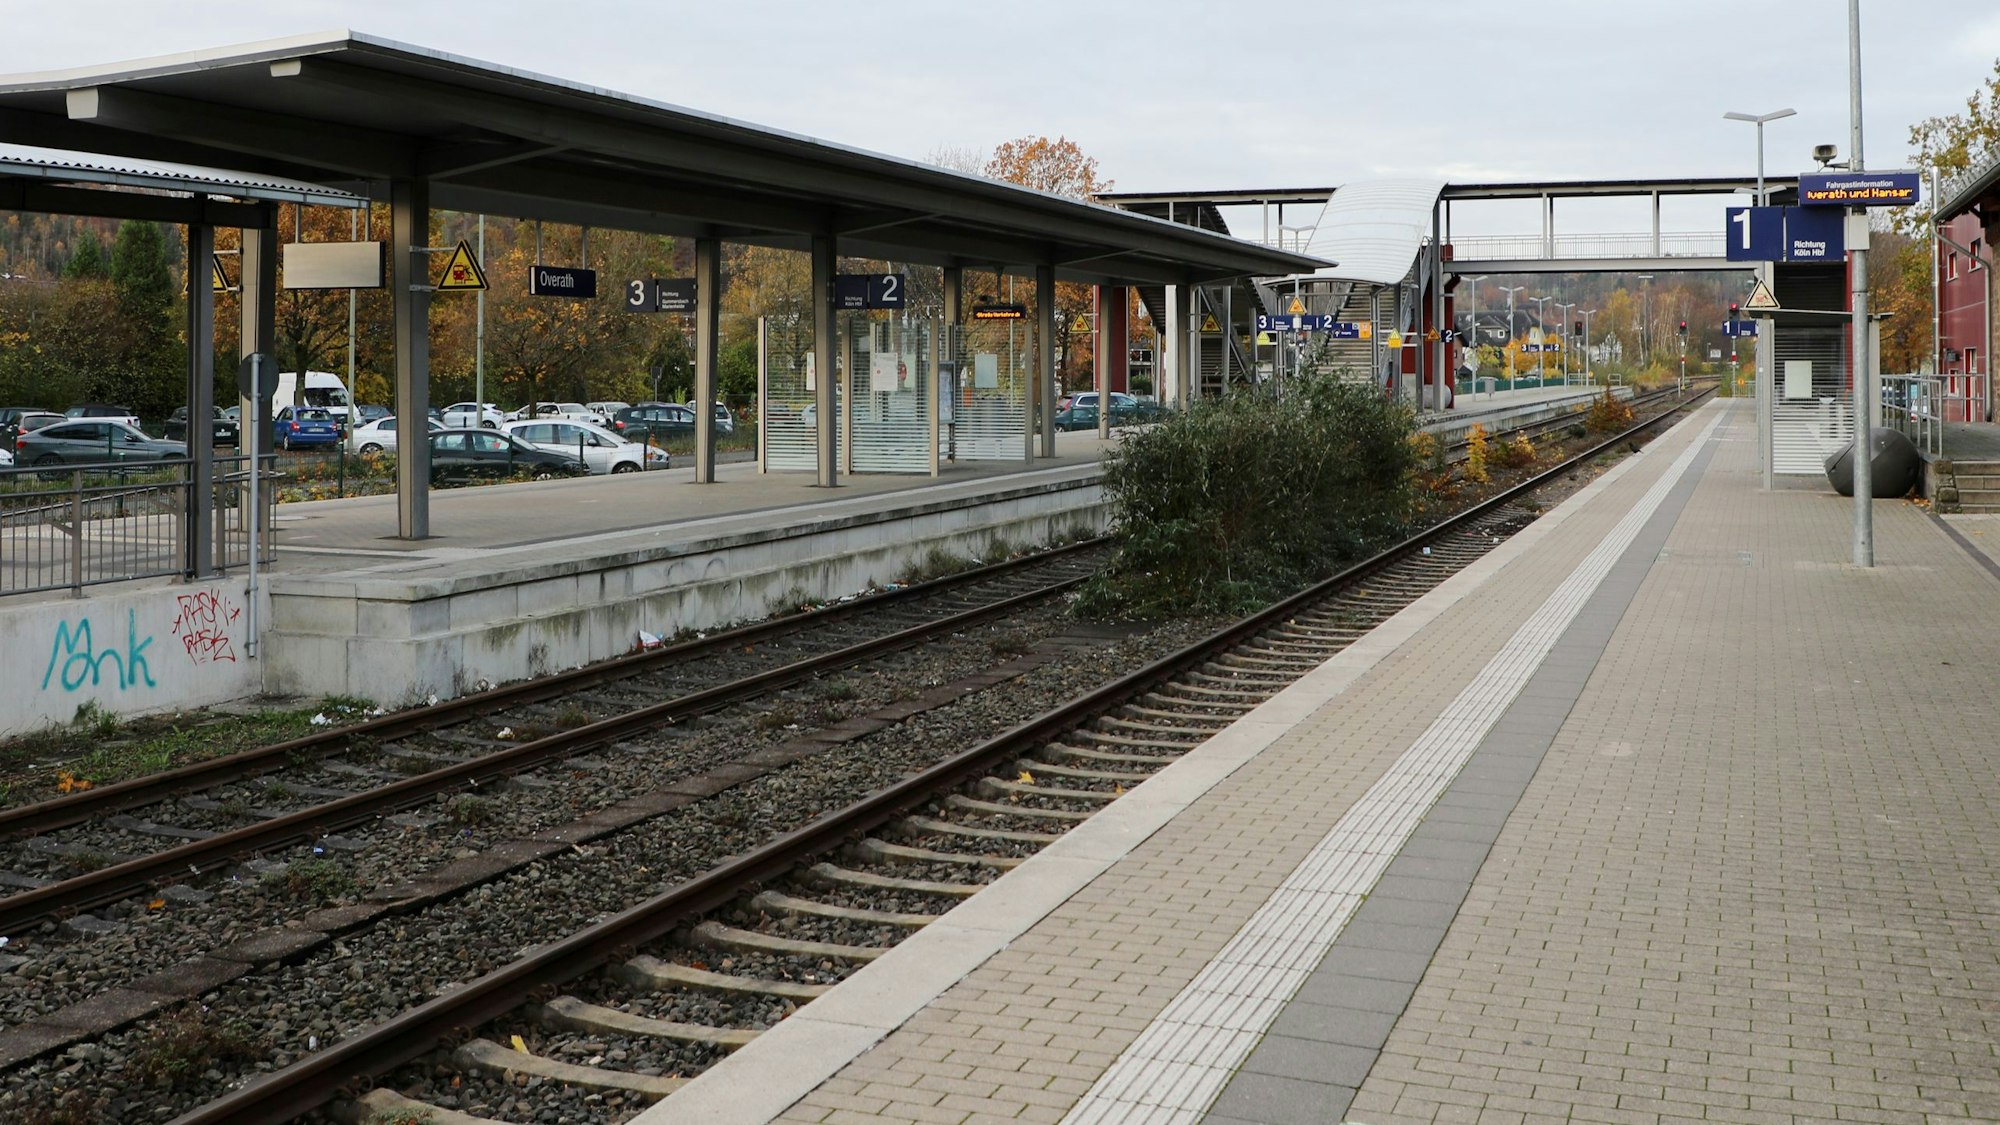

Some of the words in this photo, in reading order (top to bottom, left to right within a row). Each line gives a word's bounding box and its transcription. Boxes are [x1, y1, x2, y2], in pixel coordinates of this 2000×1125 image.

[1826, 180, 1893, 189] Fahrgastinformation
[1850, 188, 1869, 198] und
[1733, 209, 1750, 249] 1
[1794, 241, 1826, 249] Richtung
[540, 270, 574, 288] Overath
[629, 280, 645, 306] 3
[882, 275, 898, 301] 2
[1258, 315, 1267, 328] 3
[1323, 315, 1332, 328] 2
[1723, 321, 1730, 333] 1
[1445, 331, 1453, 341] 2
